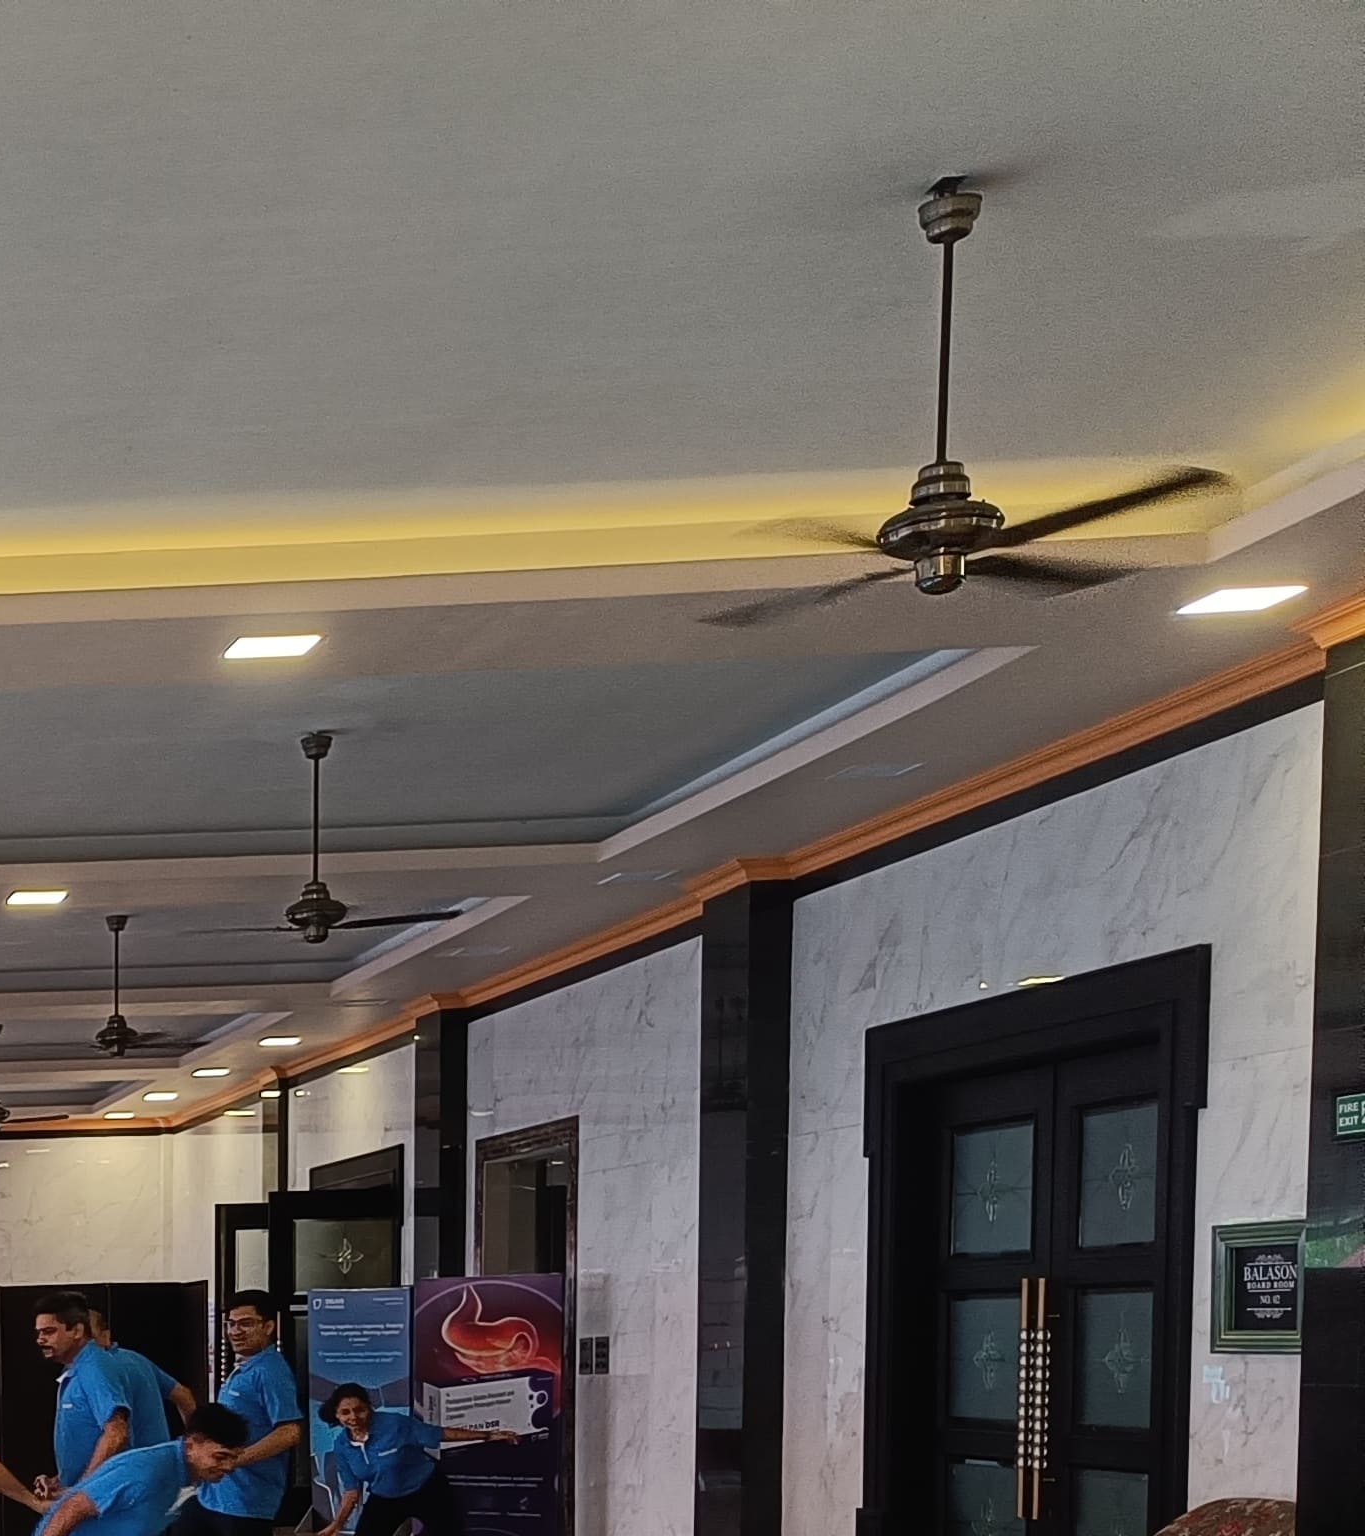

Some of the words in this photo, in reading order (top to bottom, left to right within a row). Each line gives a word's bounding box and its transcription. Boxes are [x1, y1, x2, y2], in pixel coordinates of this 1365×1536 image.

[1339, 1102, 1359, 1113] FIRE
[1339, 1115, 1359, 1127] EXIT
[1244, 1265, 1297, 1281] BALASON
